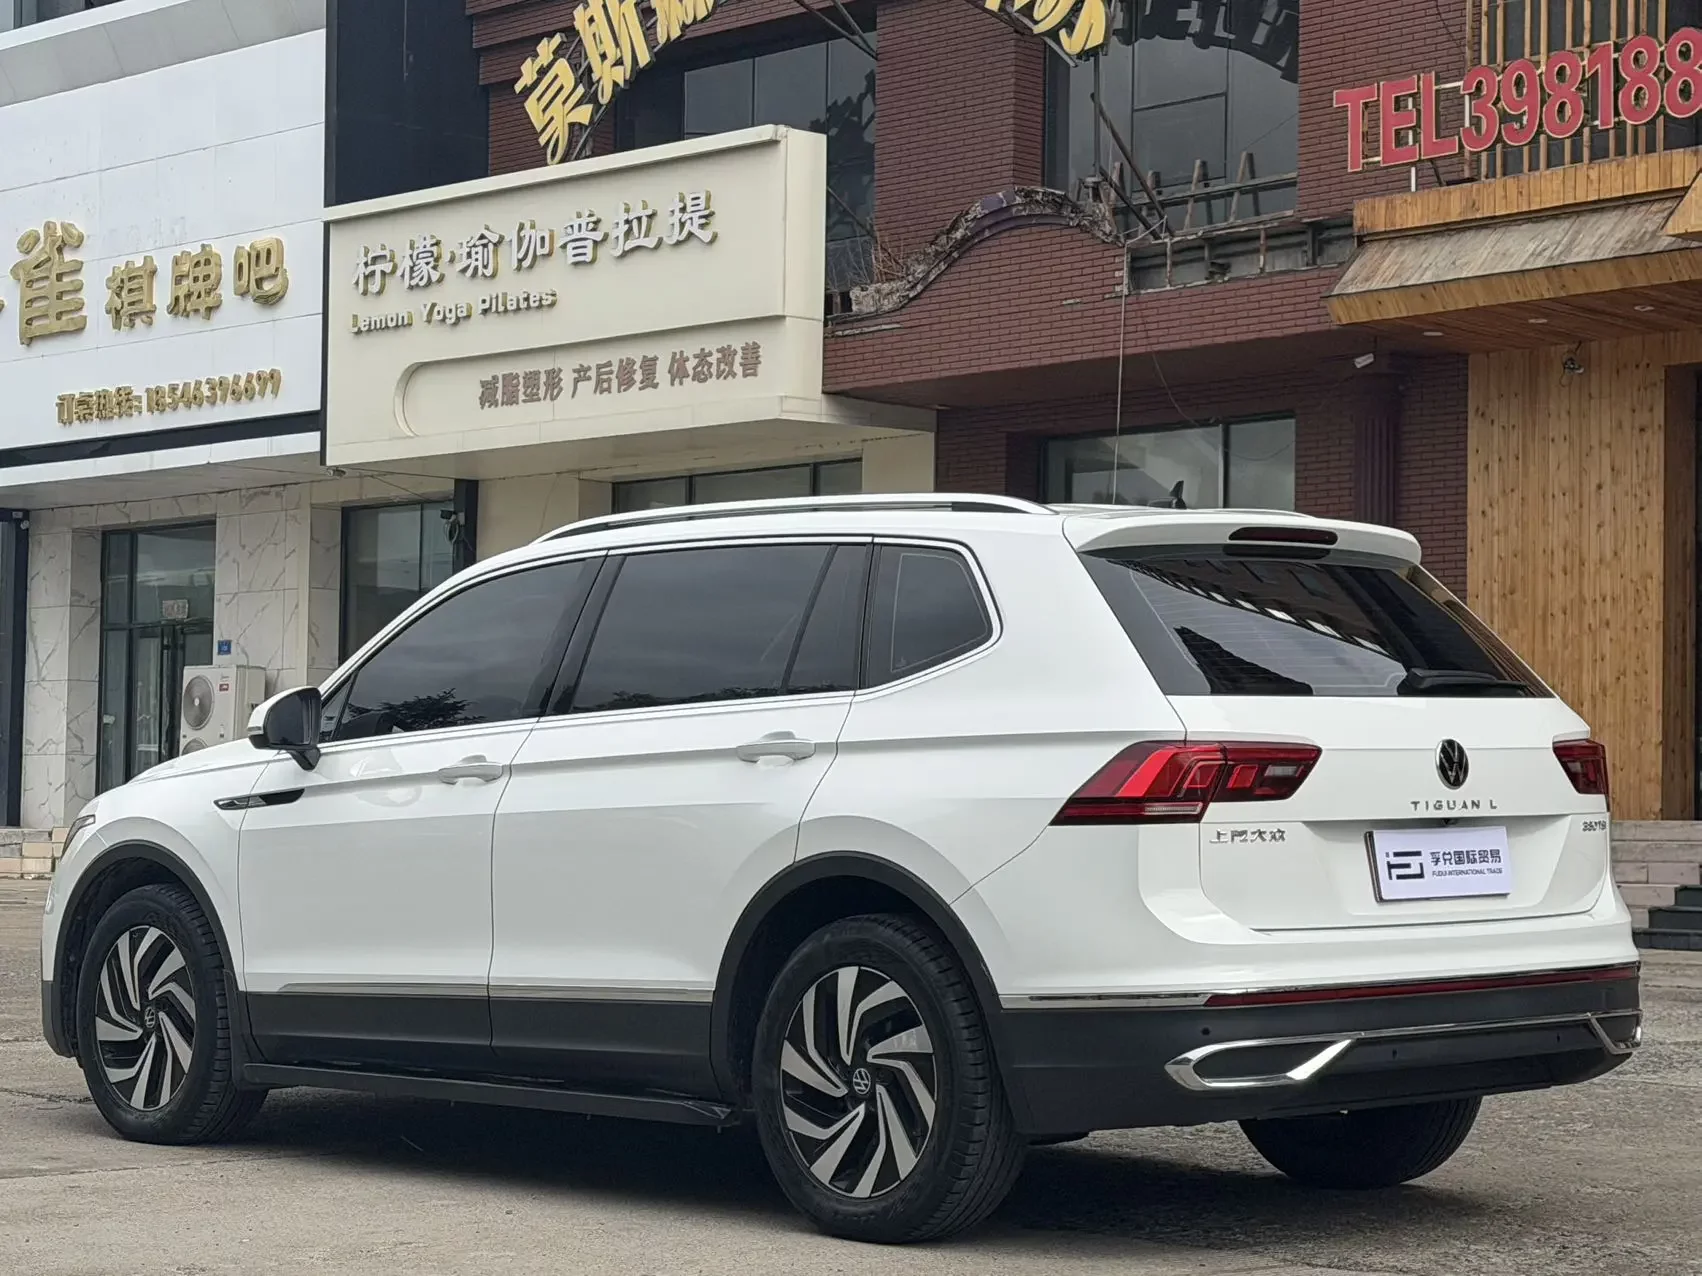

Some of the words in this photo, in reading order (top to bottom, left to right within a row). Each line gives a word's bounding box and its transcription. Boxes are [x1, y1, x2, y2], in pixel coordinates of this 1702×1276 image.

[351, 307, 413, 334] Lemon
[420, 299, 473, 324] Yoga
[478, 287, 558, 315] Pilates
[571, 352, 661, 398] 产后修复
[668, 341, 764, 383] 体态改善
[1410, 799, 1481, 812] TIGUAN
[1489, 799, 1498, 810] L
